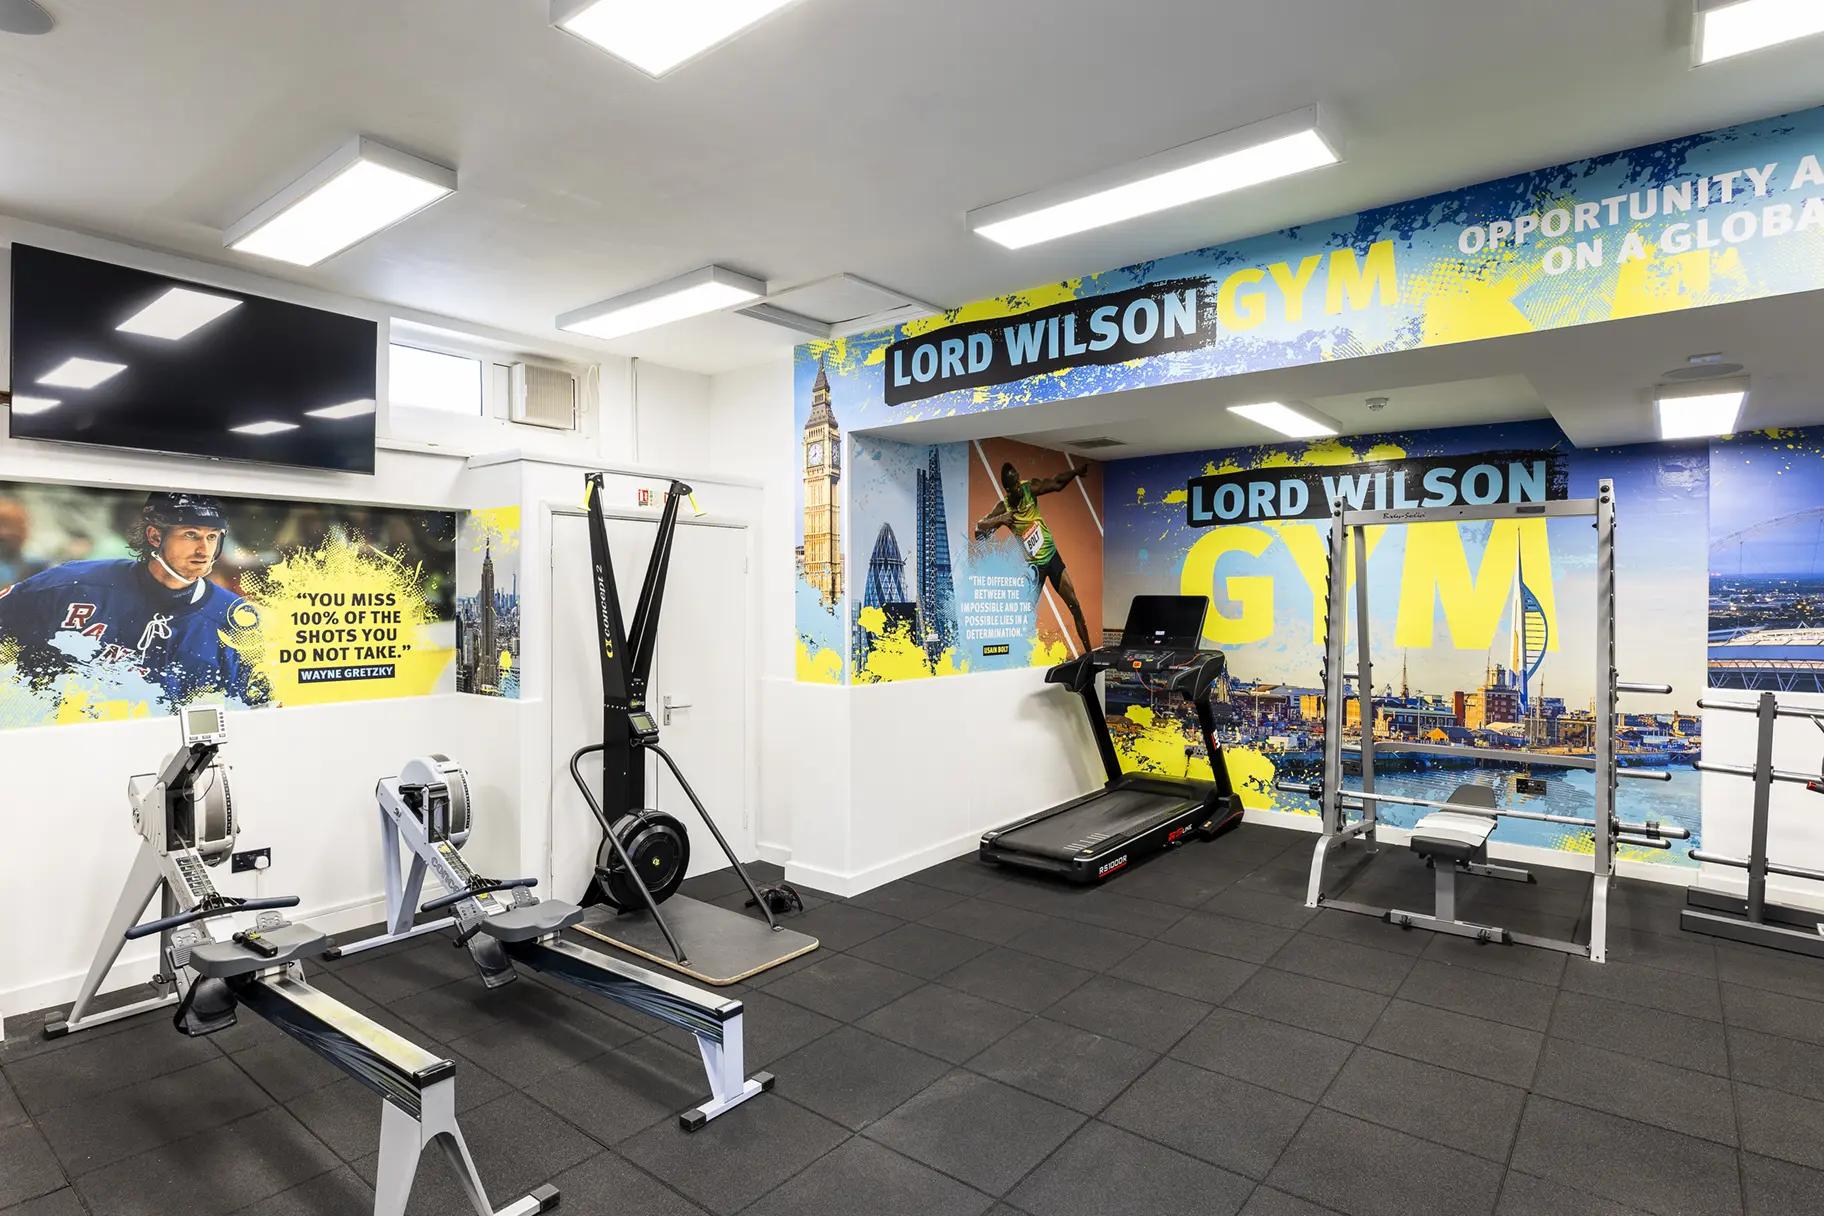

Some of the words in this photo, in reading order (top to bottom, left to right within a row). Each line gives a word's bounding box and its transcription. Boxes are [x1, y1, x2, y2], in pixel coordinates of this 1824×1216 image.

[1458, 162, 1778, 255] OPPORTUNITY
[1542, 238, 1602, 276] ON
[1617, 231, 1647, 264] A
[893, 332, 994, 388] LORD
[1003, 289, 1197, 367] WILSON
[1216, 239, 1399, 332] GYM
[1191, 478, 1310, 521] LORD
[1322, 460, 1546, 510] WILSON
[969, 575, 986, 586] “THE
[987, 576, 1024, 587] DIFFERENCE
[1180, 516, 1560, 653] GYM
[296, 593, 346, 607] “YOU
[351, 592, 397, 607] MISS
[974, 589, 1006, 600] BETWEEN
[1007, 589, 1020, 600] THE
[597, 576, 611, 637] concept
[960, 602, 1003, 613] IMPOSSIBLE
[1004, 602, 1018, 612] AND
[1019, 602, 1032, 612] THE
[291, 611, 340, 626] 100%
[344, 611, 367, 625] OF
[371, 610, 402, 624] THE
[965, 615, 999, 627] POSSIBLE
[1000, 615, 1014, 625] LIES
[1015, 614, 1023, 625] IN
[1023, 614, 1028, 625] A
[295, 629, 358, 644] SHOTS
[362, 628, 398, 642] YOU
[279, 648, 307, 664] DO
[313, 647, 350, 662] NOT
[354, 644, 412, 660] TAKE.”
[983, 645, 998, 655] USAIN
[998, 645, 1009, 654] BOLT
[301, 669, 342, 681] WAYNE
[344, 666, 394, 679] GRETZKY
